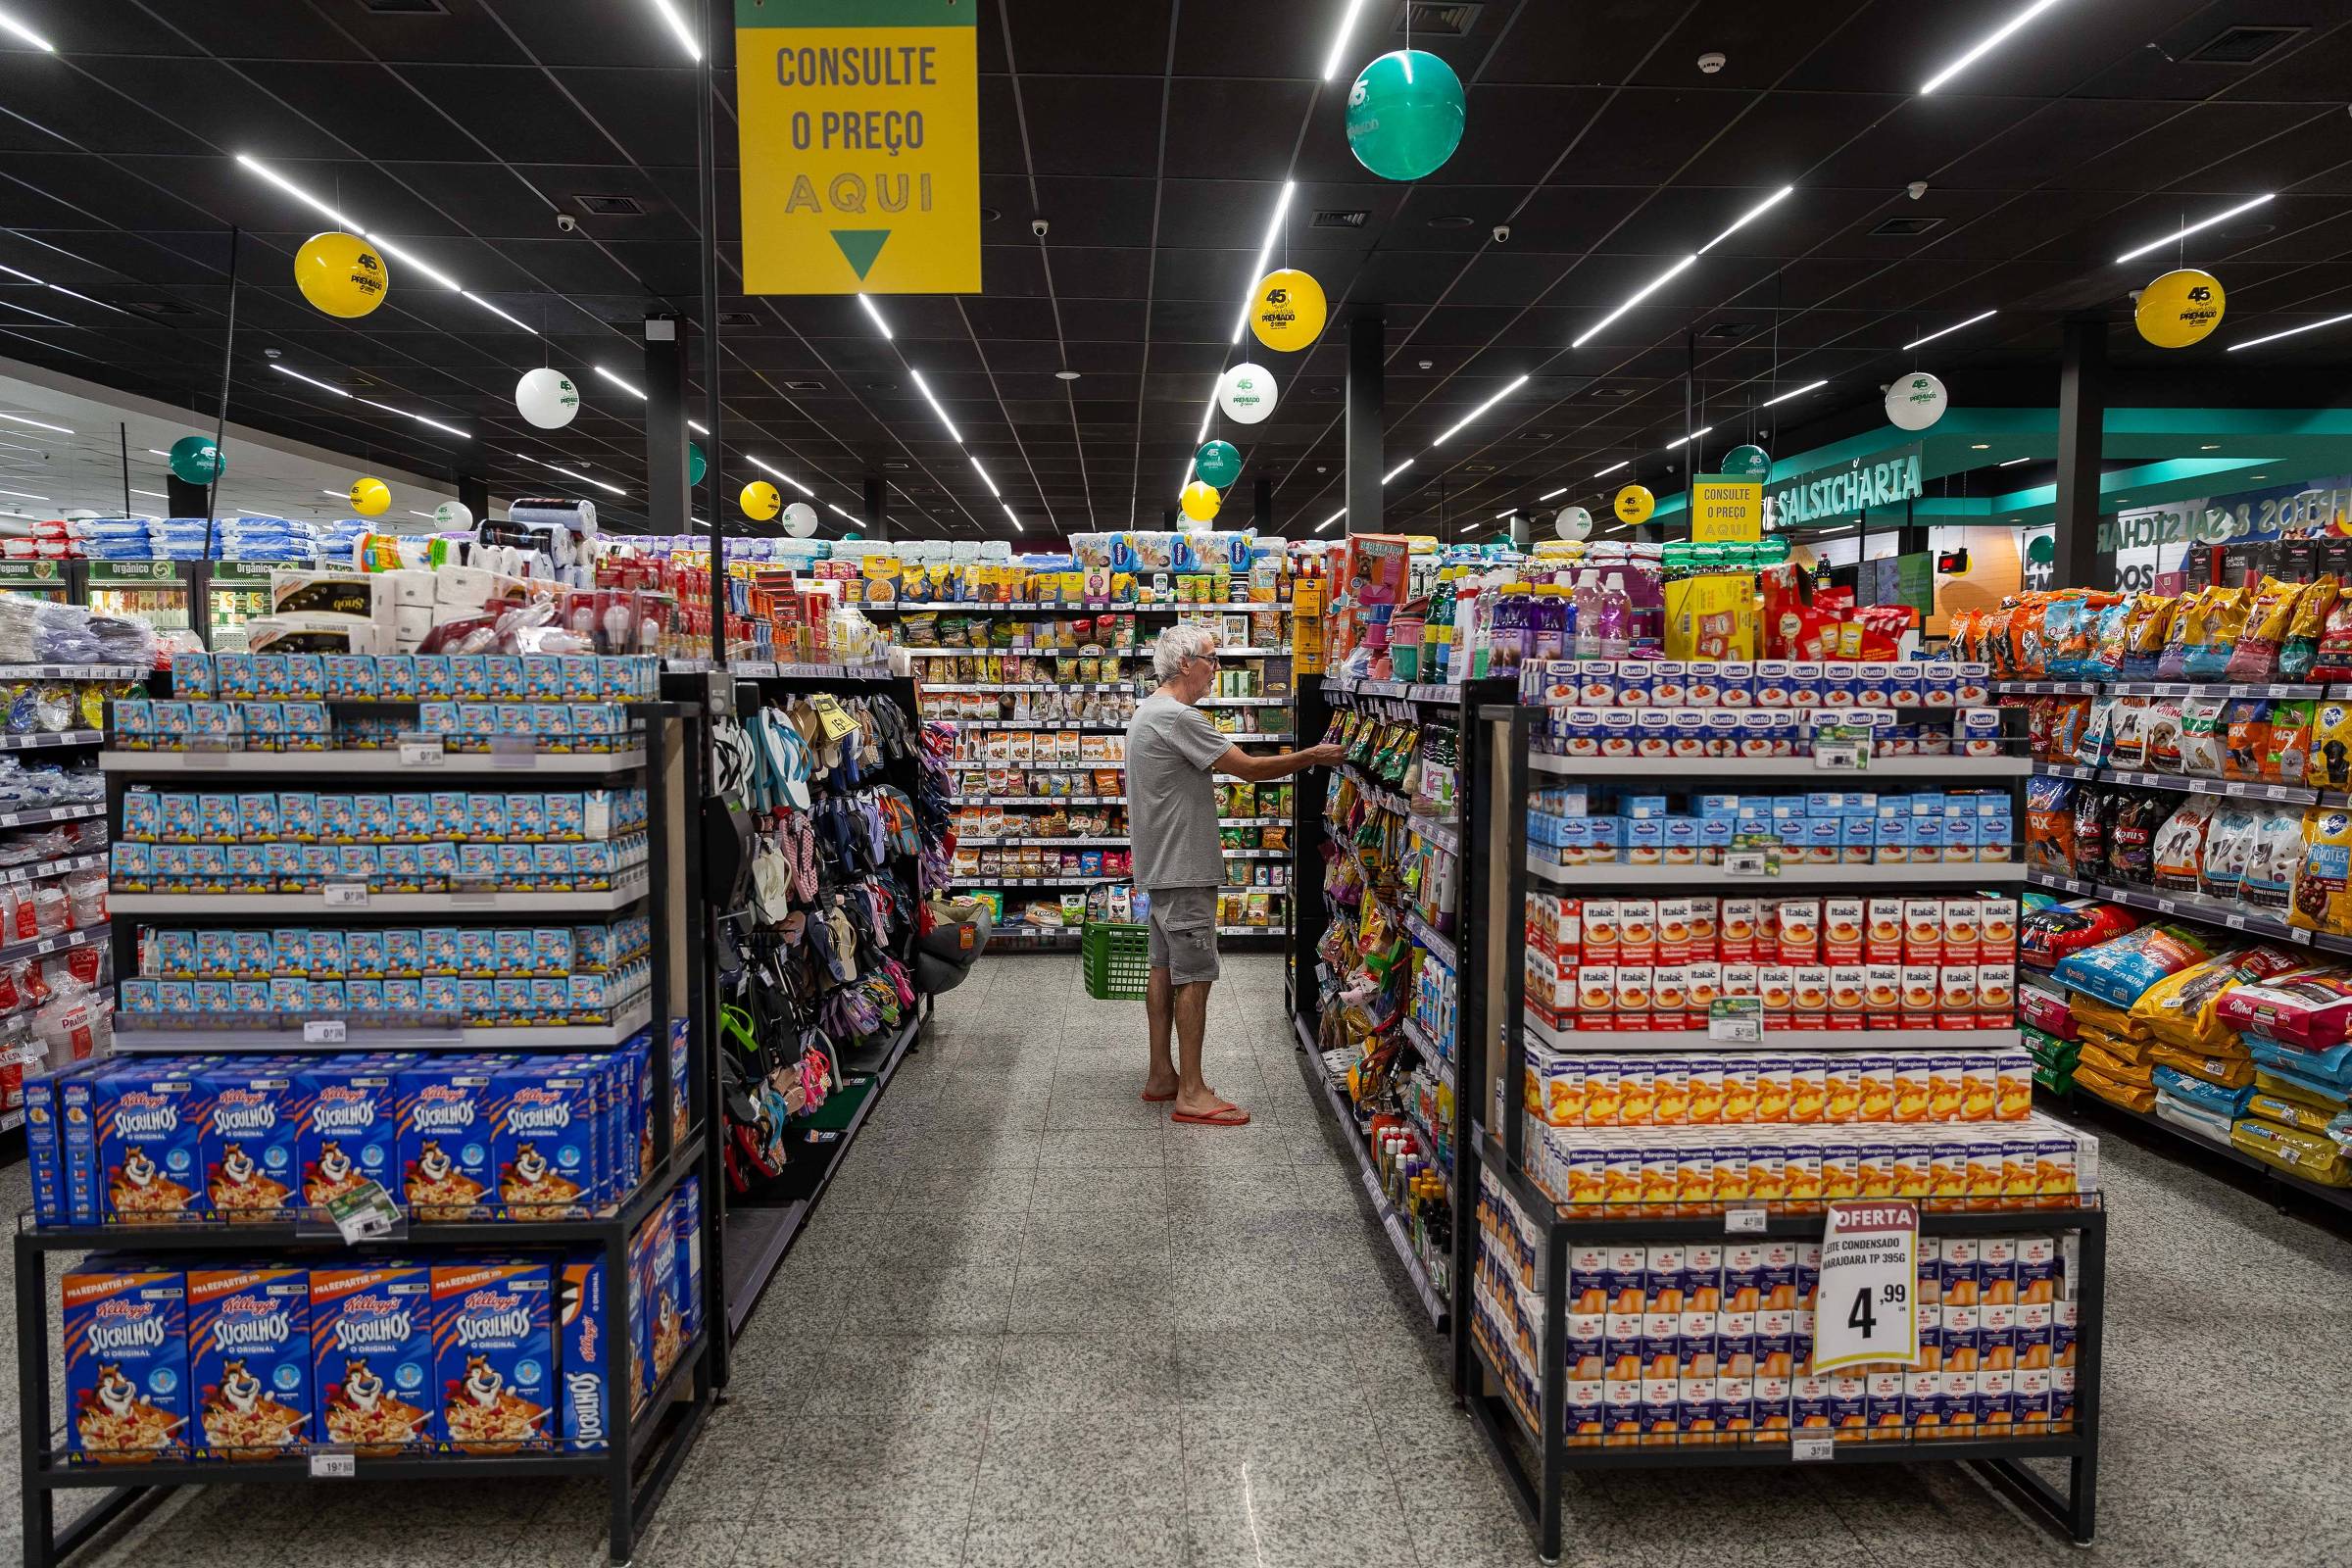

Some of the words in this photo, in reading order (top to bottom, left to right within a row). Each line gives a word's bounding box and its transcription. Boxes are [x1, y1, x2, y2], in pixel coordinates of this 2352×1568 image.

[776, 46, 937, 86] CONSULTE
[792, 111, 811, 150] O
[821, 110, 924, 156] PREÇO
[784, 172, 933, 215] AQUI
[358, 254, 377, 270] 45
[1266, 289, 1286, 303] 45
[2186, 287, 2211, 301] 45
[2180, 311, 2217, 321] PREMIADO
[1237, 379, 1252, 390] 45
[1912, 379, 1928, 389] 45
[1703, 488, 1751, 501] CONSULTE
[1778, 455, 1925, 527] SALSICHARIA
[1707, 508, 1714, 518] O
[1716, 507, 1746, 520] PREÇO
[1705, 524, 1747, 536] AQUI
[0, 564, 29, 574] eganos
[112, 562, 149, 573] Orgânico
[237, 562, 273, 573] Orgânico
[334, 598, 365, 610] Snob
[2029, 815, 2050, 830] AX
[1589, 907, 1614, 917] Italac
[1624, 907, 1649, 917] Italac
[1662, 906, 1688, 916] Italac
[1728, 905, 1752, 914] Italac
[1786, 907, 1812, 917] Italac
[1911, 907, 1936, 917] Italac
[1949, 907, 1975, 917] Italac
[1985, 906, 2011, 916] Italac
[1584, 971, 1609, 981] Italac
[1621, 972, 1646, 982] Italac
[1657, 973, 1683, 982] Italac
[1691, 969, 1715, 979] Italac
[1727, 972, 1752, 981] Italac
[1870, 970, 1896, 979] Italac
[1907, 971, 1932, 981] Italac
[1946, 973, 1972, 982] Italac
[1588, 1062, 1619, 1071] Marajoara
[1622, 1062, 1653, 1071] Marajoara
[1656, 1061, 1688, 1071] Marajoara
[1691, 1061, 1723, 1070] Marajoara
[1726, 1061, 1756, 1070] Marajoara
[1862, 1059, 1893, 1068] Marajoara
[1896, 1059, 1929, 1069] Marajoara
[1931, 1059, 1961, 1068] Marajoara
[1964, 1058, 1995, 1067] Marajoara
[2000, 1057, 2032, 1066] Marajoara
[1552, 1062, 1585, 1072] Marajoara
[114, 1103, 178, 1140] SUCRILHOS
[214, 1102, 276, 1137] SUCRILHOS
[313, 1100, 375, 1134] SUCRILHOS
[413, 1100, 475, 1133] SUCRILHOS
[507, 1101, 570, 1136] SUCRILHOS
[1862, 1147, 1893, 1155] Marajoara
[2038, 1143, 2071, 1152] Marajoara
[1571, 1152, 1603, 1160] Marajoara
[1642, 1151, 1676, 1159] Marajoara
[1838, 1208, 1913, 1226] OFERTA
[1841, 1238, 1900, 1250] CONDENSADO
[1823, 1255, 1867, 1270] MARAJOARA
[1869, 1254, 1880, 1265] TP
[1883, 1252, 1906, 1263] 395G
[206, 1275, 249, 1293] REPARTIR
[328, 1274, 371, 1291] REPARTIR
[451, 1271, 492, 1288] REPARTIR
[80, 1278, 123, 1296] REPARTIR
[221, 1294, 281, 1316] Kellogg's
[344, 1294, 403, 1314] Kellogg's
[465, 1290, 522, 1310] Kellogg's
[96, 1298, 156, 1320] Kellogg's
[1847, 1287, 1877, 1339] 4
[214, 1311, 289, 1351] SUCRILHOS
[335, 1309, 412, 1351] SUCRILHOS
[457, 1306, 530, 1347] SUCRILHOS
[88, 1314, 165, 1356] SUCRILHOS
[237, 1346, 275, 1354] ORIGINAL
[359, 1345, 398, 1353] ORIGINAL
[479, 1341, 517, 1349] ORIGINAL
[111, 1349, 151, 1358] ORIGINAL
[566, 1371, 609, 1450] SUCRILHOS
